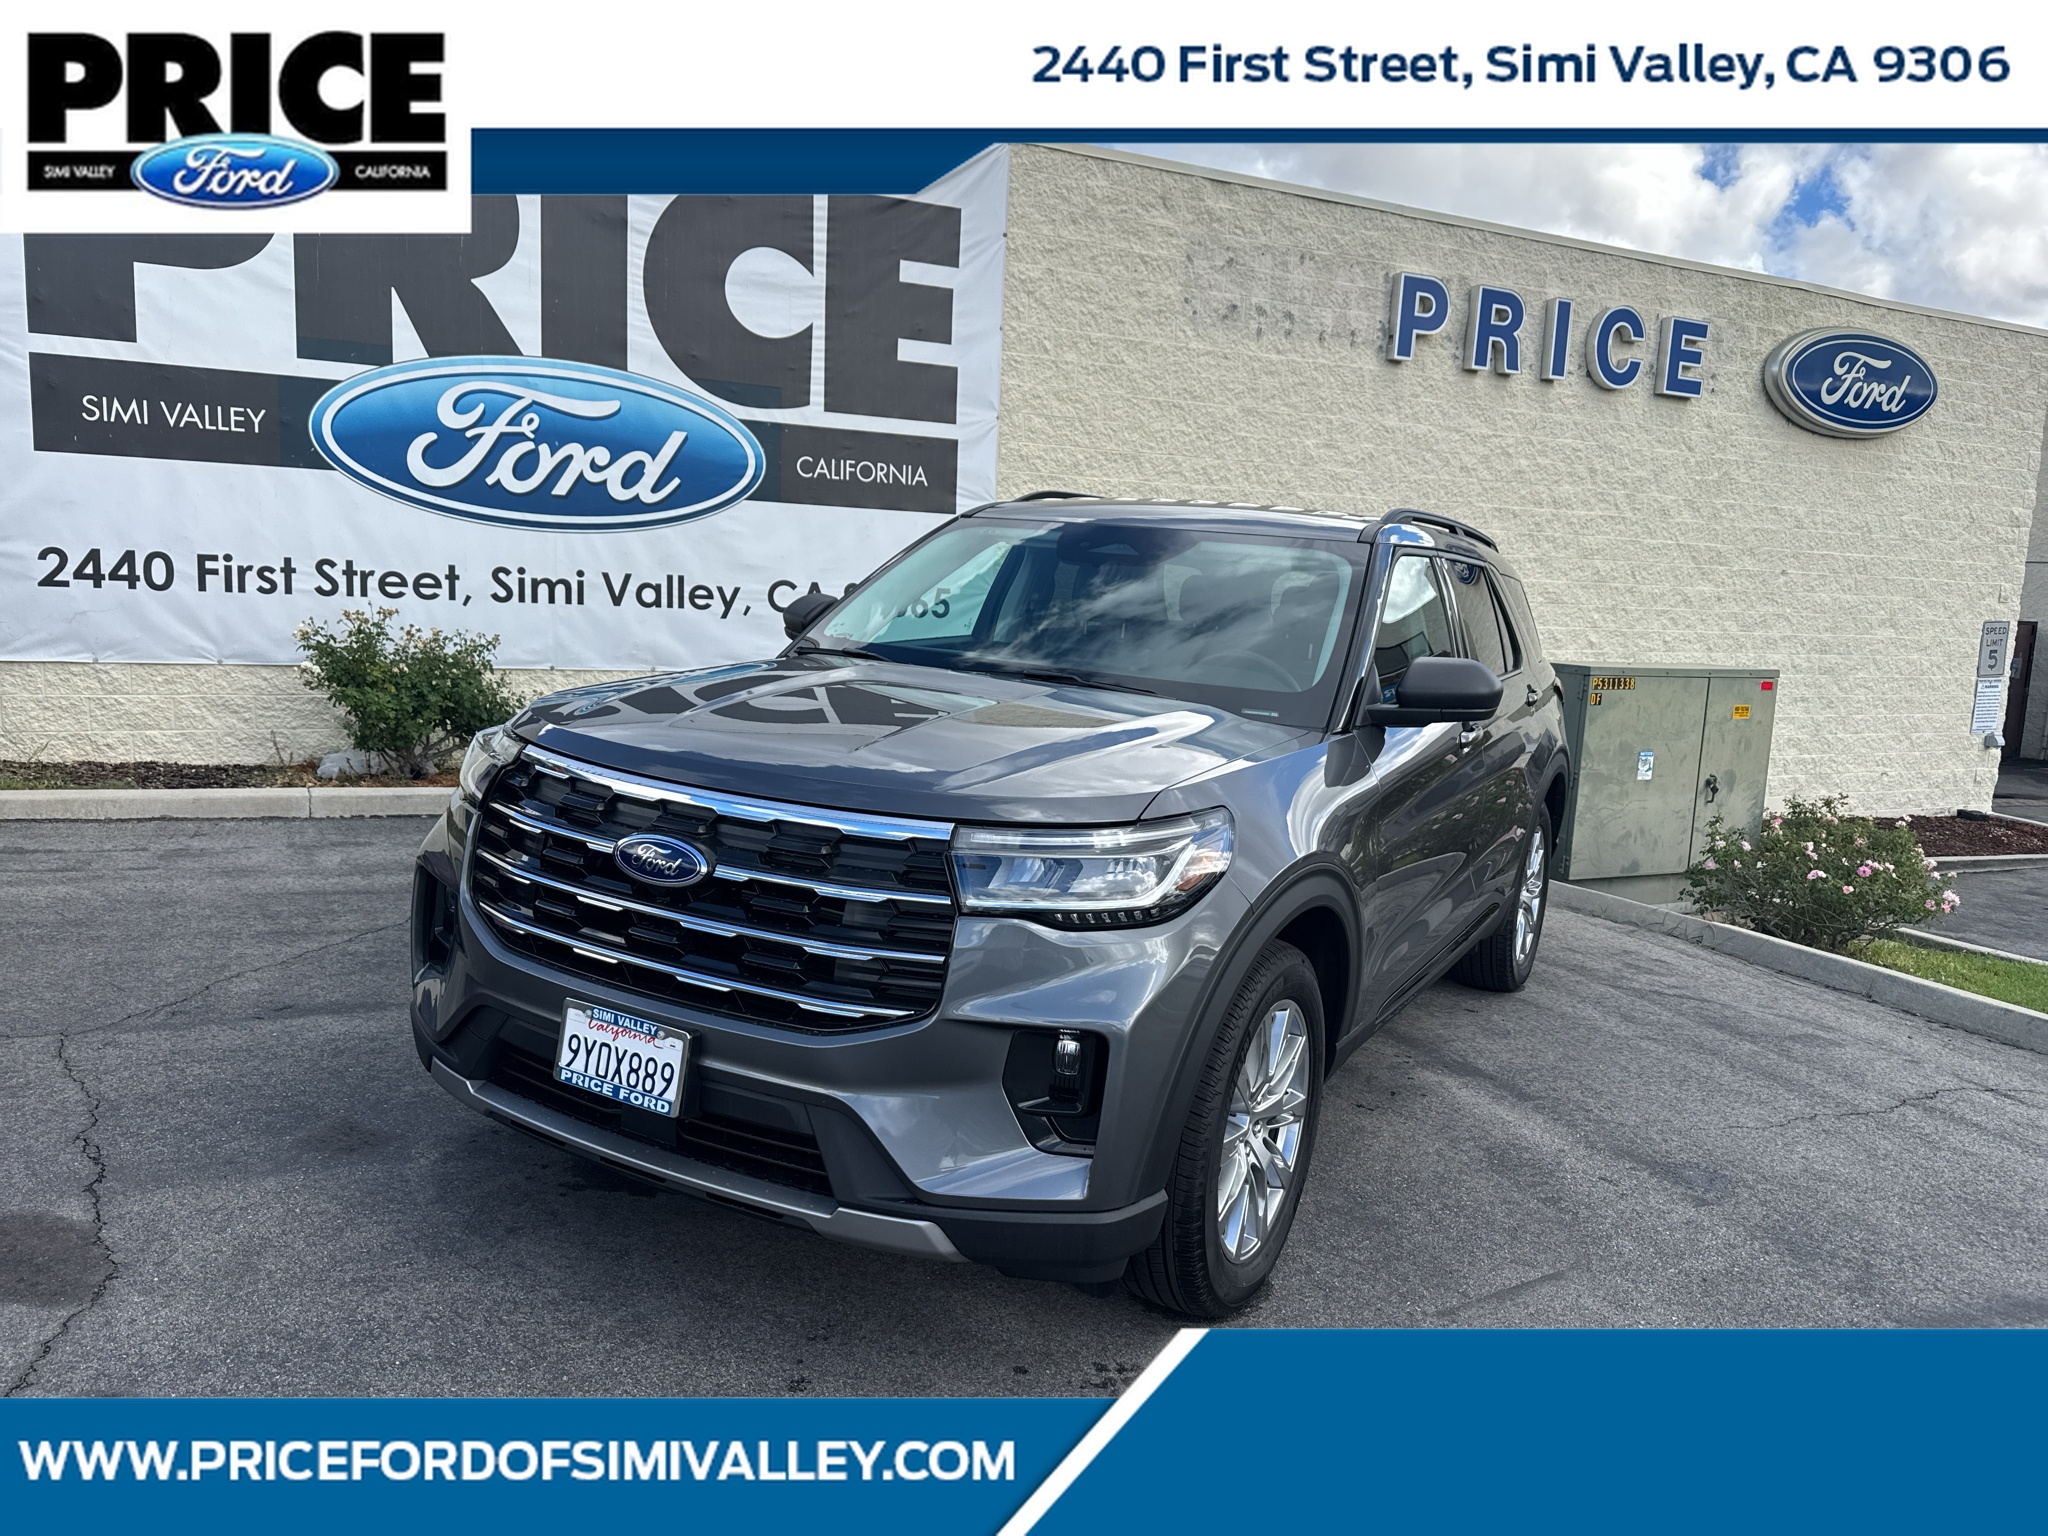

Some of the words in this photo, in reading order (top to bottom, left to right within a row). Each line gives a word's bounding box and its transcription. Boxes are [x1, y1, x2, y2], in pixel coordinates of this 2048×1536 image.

[1387, 272, 1710, 398] PRICE
[1820, 351, 1912, 413] Ford
[81, 395, 149, 425] SIMI
[159, 400, 267, 434] VALLEY
[406, 380, 688, 505] Ford
[796, 455, 929, 487] CALIFORNIA
[37, 546, 175, 592] 2440
[196, 553, 297, 595] First
[314, 558, 473, 607] Street,
[490, 566, 585, 606] Simi
[601, 572, 751, 620] Valley,
[1985, 626, 2007, 635] SPEED
[1986, 639, 2004, 647] LIMIT
[1987, 650, 1998, 670] 5
[631, 843, 683, 877] Ford
[592, 1008, 615, 1023] SIMI
[617, 1016, 658, 1035] VALLEY
[560, 1069, 614, 1096] PRICE
[618, 1088, 670, 1114] FORD
